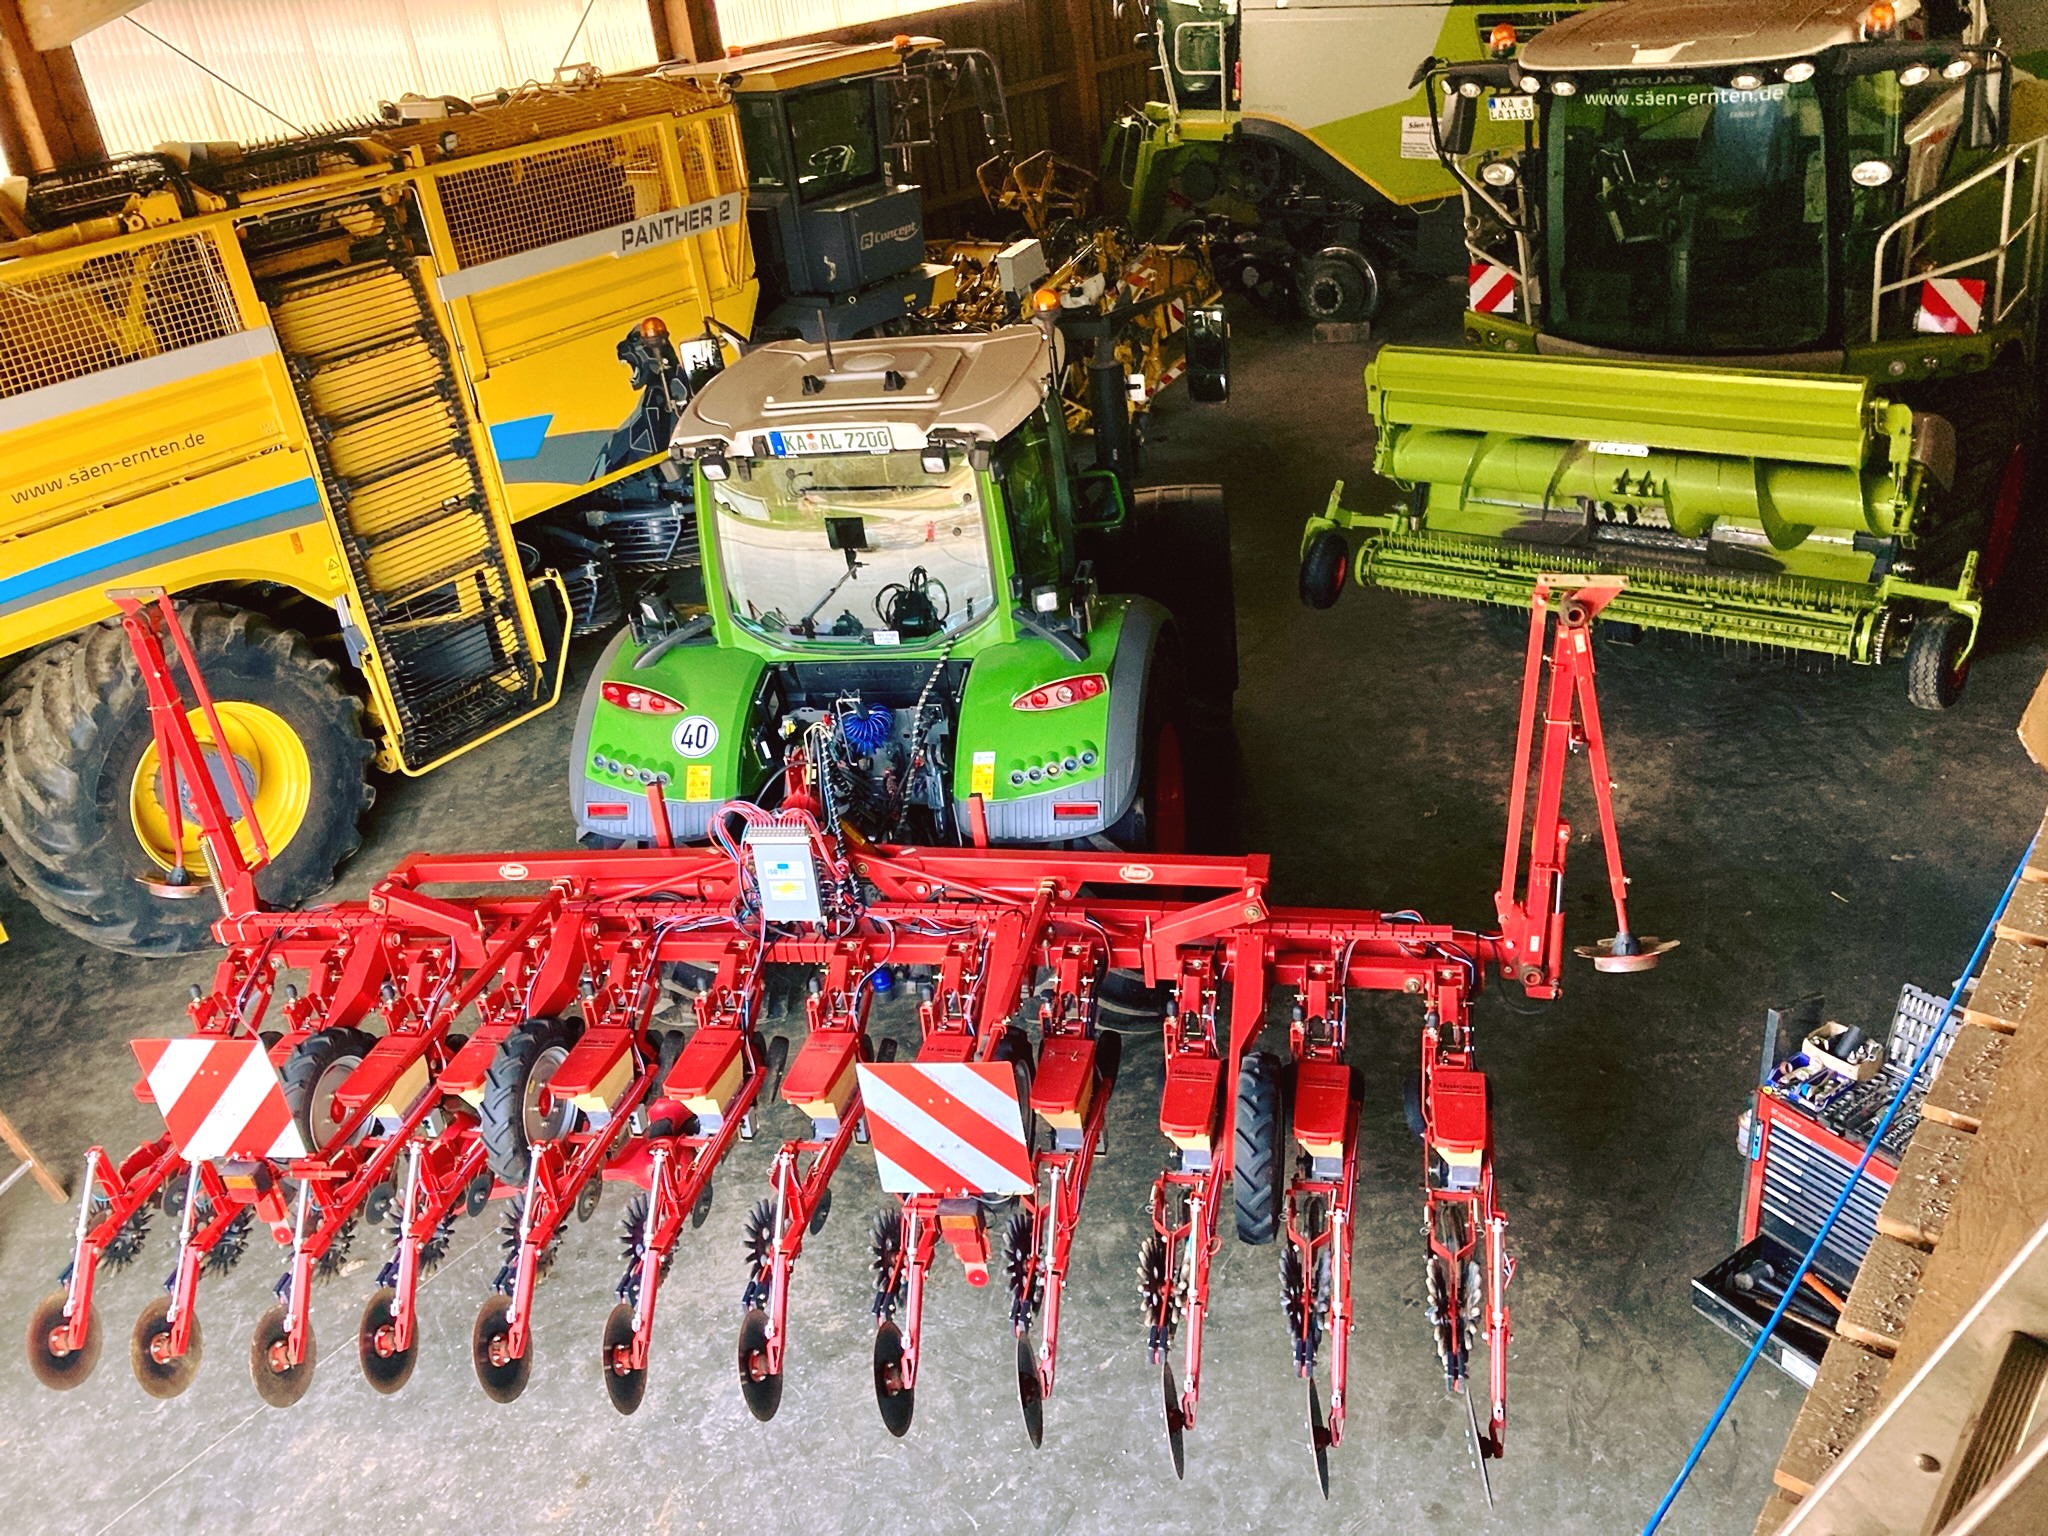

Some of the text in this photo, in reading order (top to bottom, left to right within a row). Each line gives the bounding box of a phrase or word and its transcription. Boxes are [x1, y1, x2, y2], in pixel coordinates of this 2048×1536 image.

[1611, 75, 1695, 86] JAGUAR
[1501, 98, 1514, 108] KA
[1584, 87, 1785, 107] www.säen-ernten.de
[621, 199, 731, 251] PANTHER 2
[874, 221, 916, 243] Concept
[783, 433, 808, 452] KA
[10, 433, 206, 505] www.säen-ernten.de
[680, 723, 709, 749] 40
